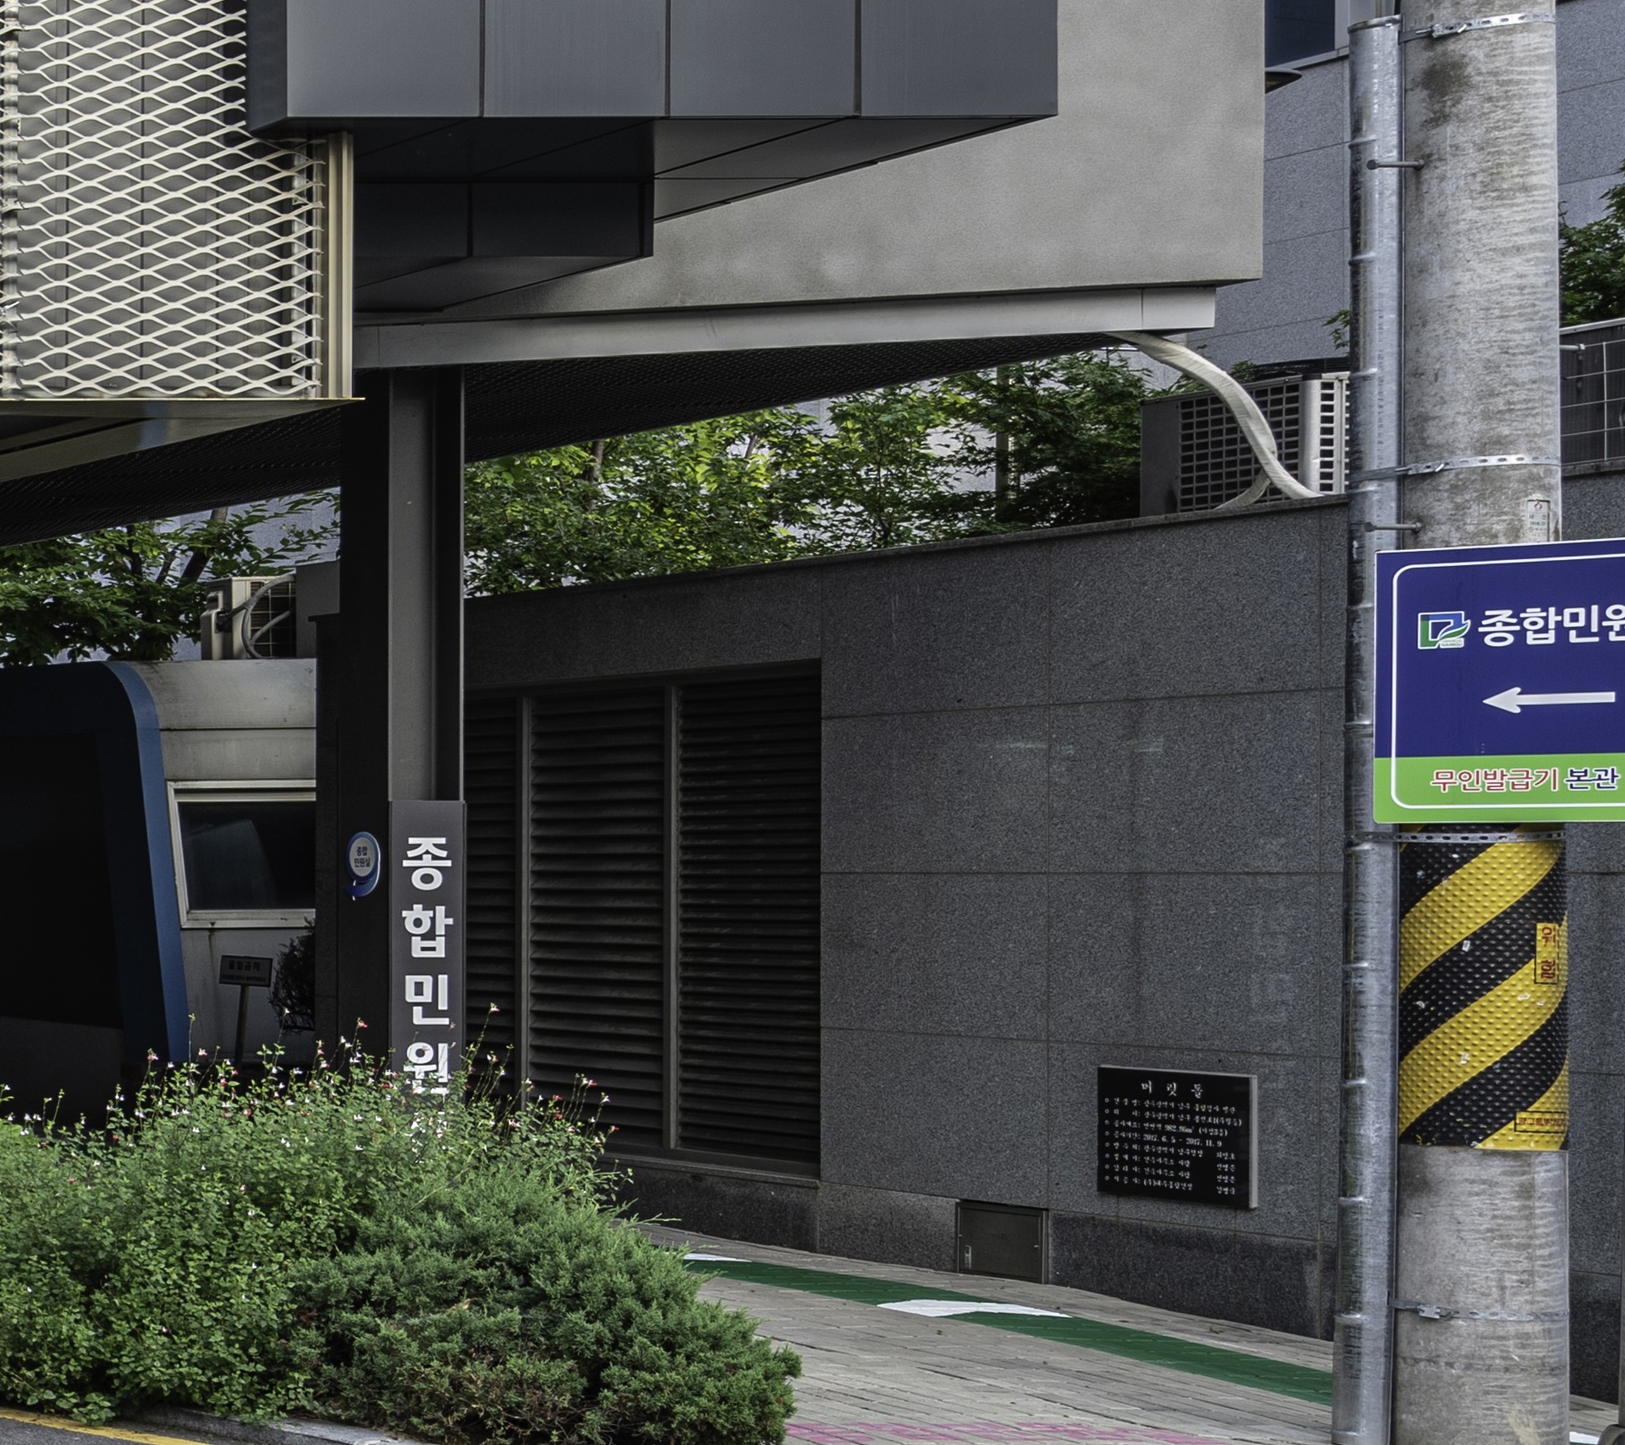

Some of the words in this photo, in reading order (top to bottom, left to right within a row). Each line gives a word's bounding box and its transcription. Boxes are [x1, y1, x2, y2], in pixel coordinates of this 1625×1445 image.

[1478, 604, 1625, 647] 종합민원
[1431, 767, 1559, 793] 무인발급기
[1565, 766, 1619, 791] 본관
[402, 837, 454, 1132] 종합민원
[1141, 1080, 1203, 1099] 머릿돌
